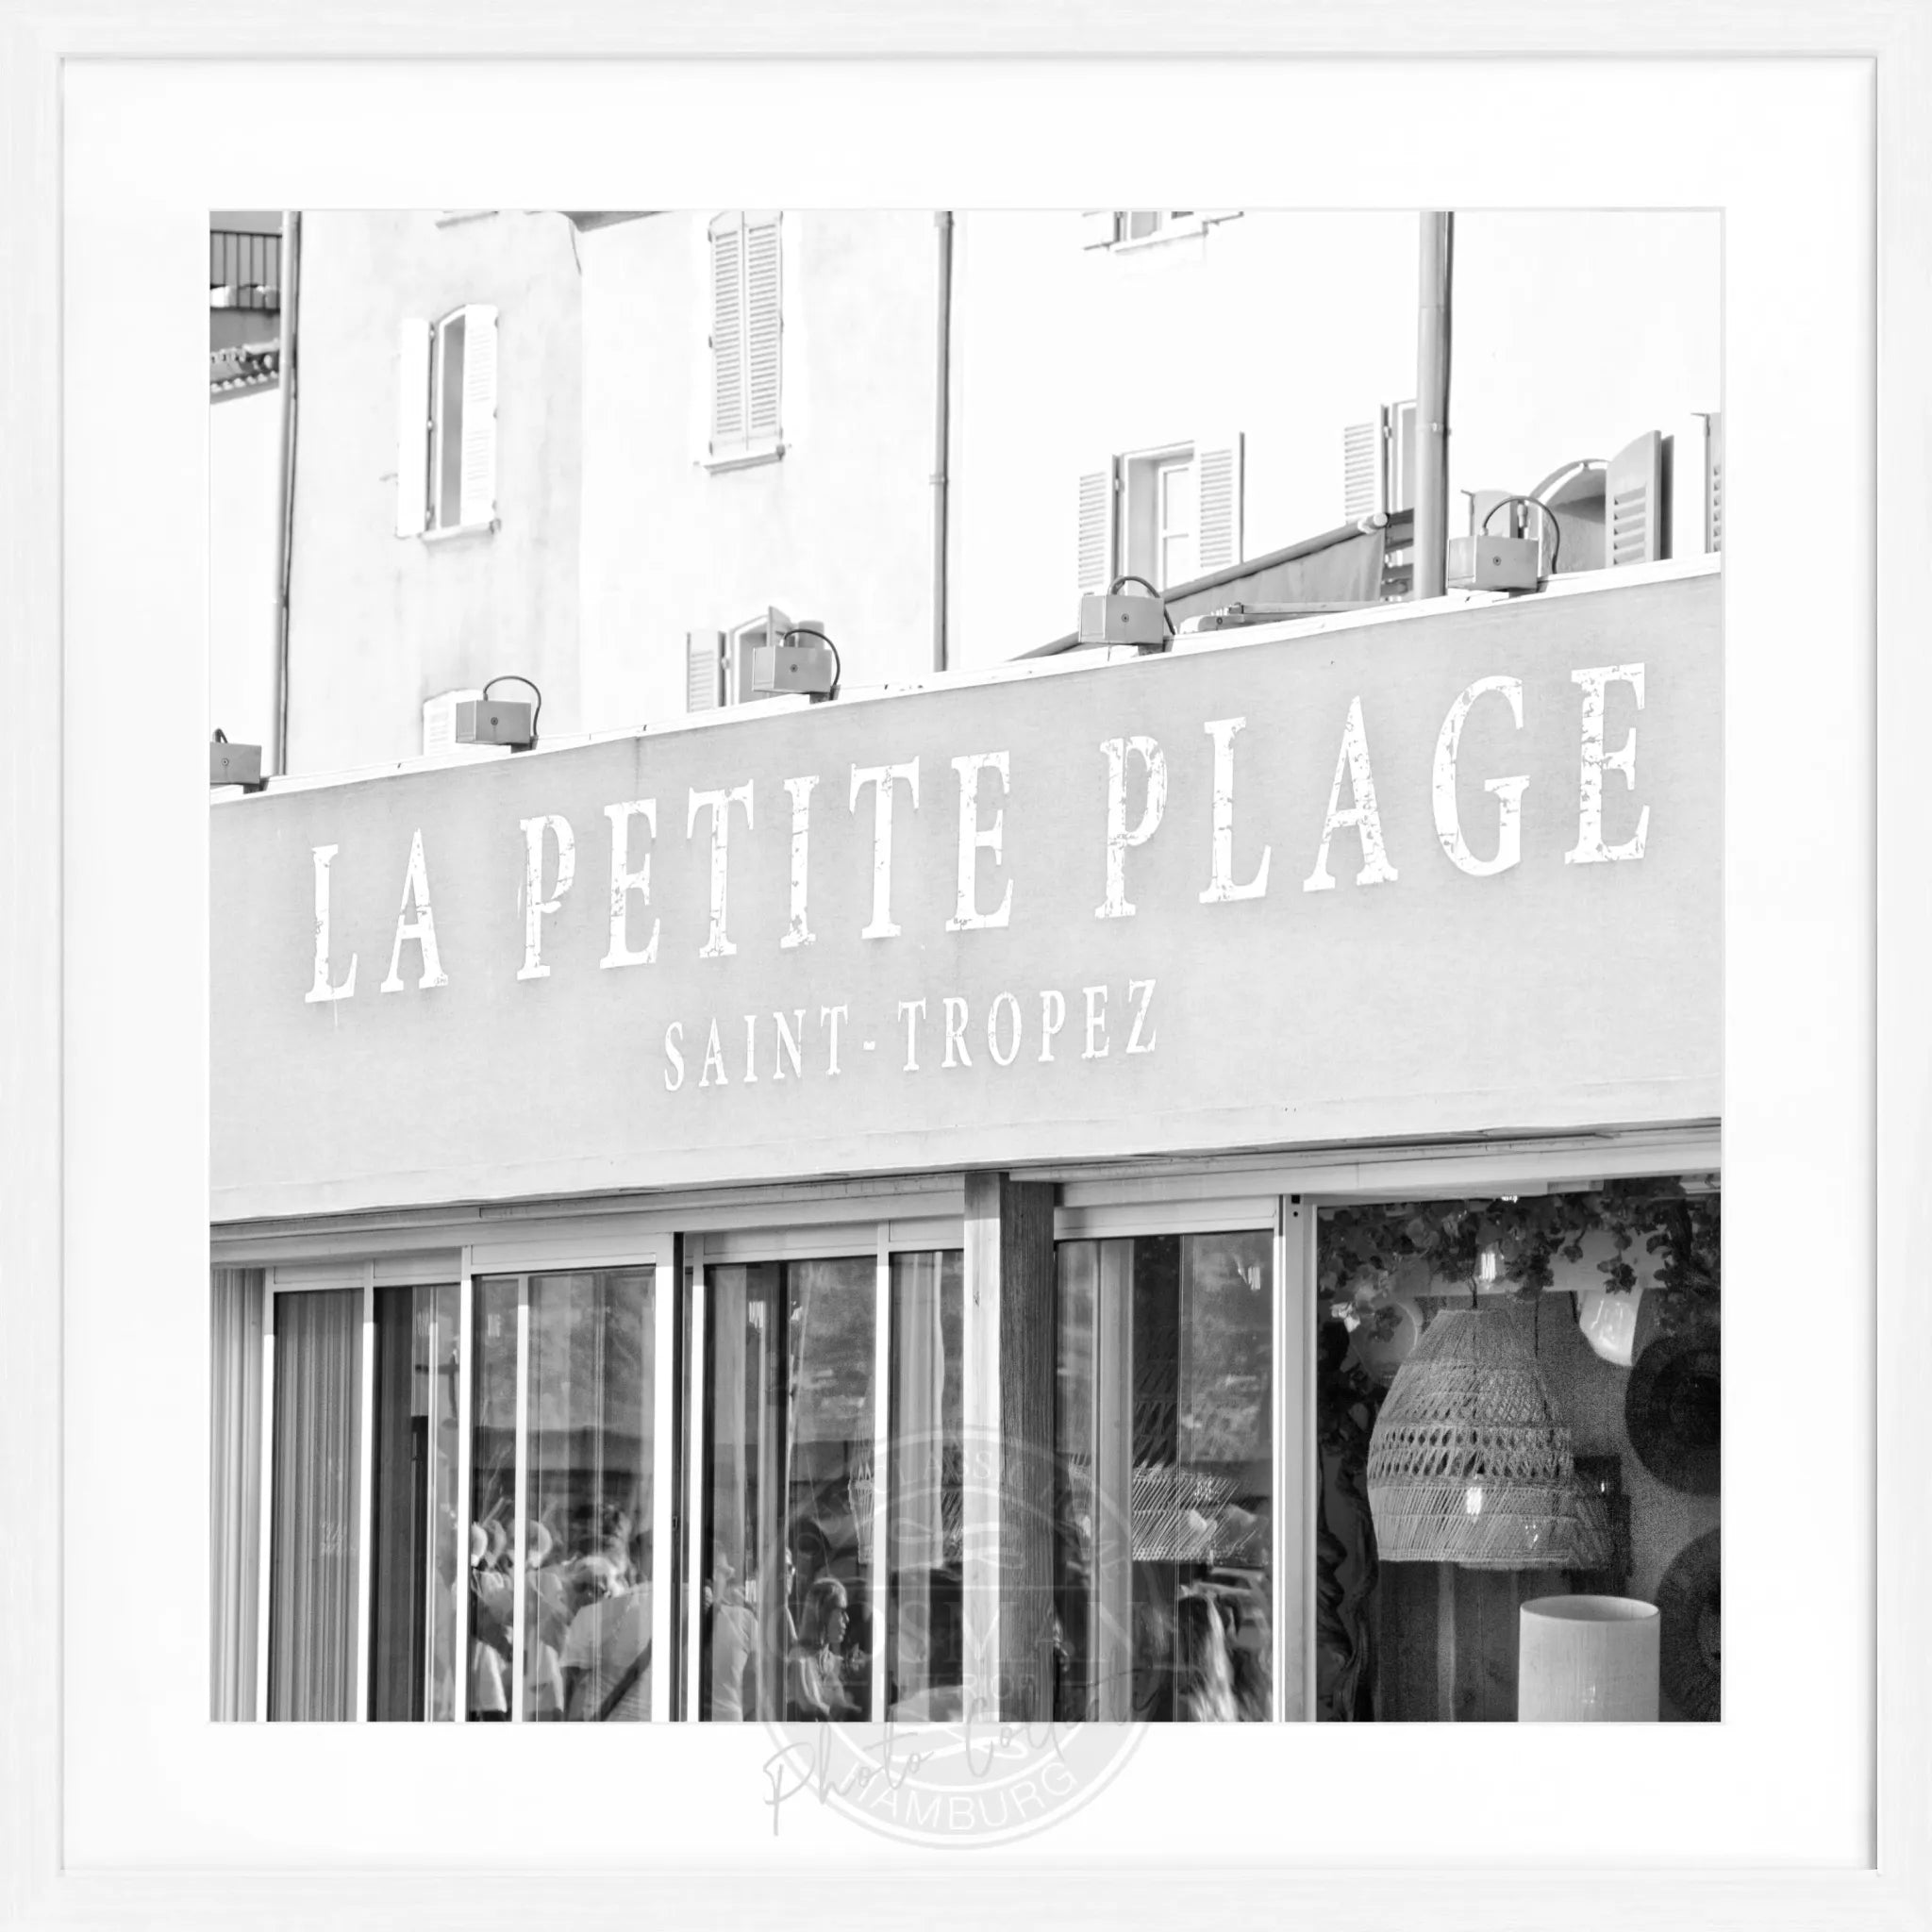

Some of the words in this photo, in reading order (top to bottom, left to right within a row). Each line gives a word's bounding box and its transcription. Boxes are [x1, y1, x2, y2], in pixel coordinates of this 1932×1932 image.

[306, 829, 448, 1002] LA
[516, 751, 1014, 980] PETITE
[1094, 662, 1651, 920] PLAGE
